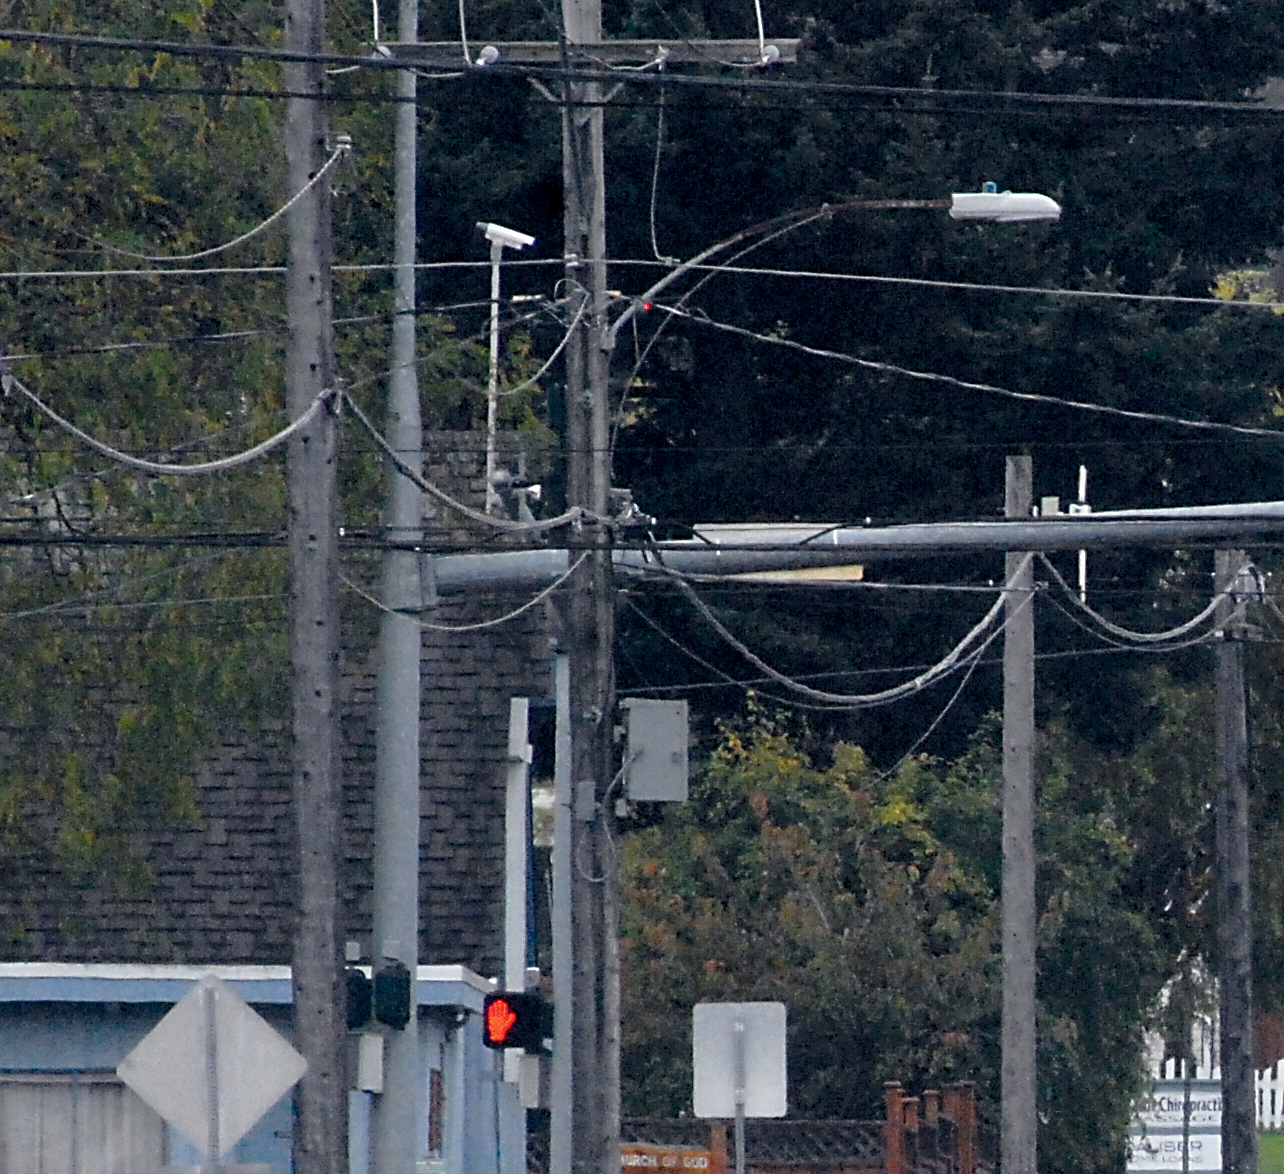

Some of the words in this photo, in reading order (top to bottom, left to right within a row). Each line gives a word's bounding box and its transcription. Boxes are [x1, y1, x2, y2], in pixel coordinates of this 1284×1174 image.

[621, 1154, 658, 1167] URCH
[662, 1156, 677, 1168] OF
[682, 1156, 708, 1169] GOD
